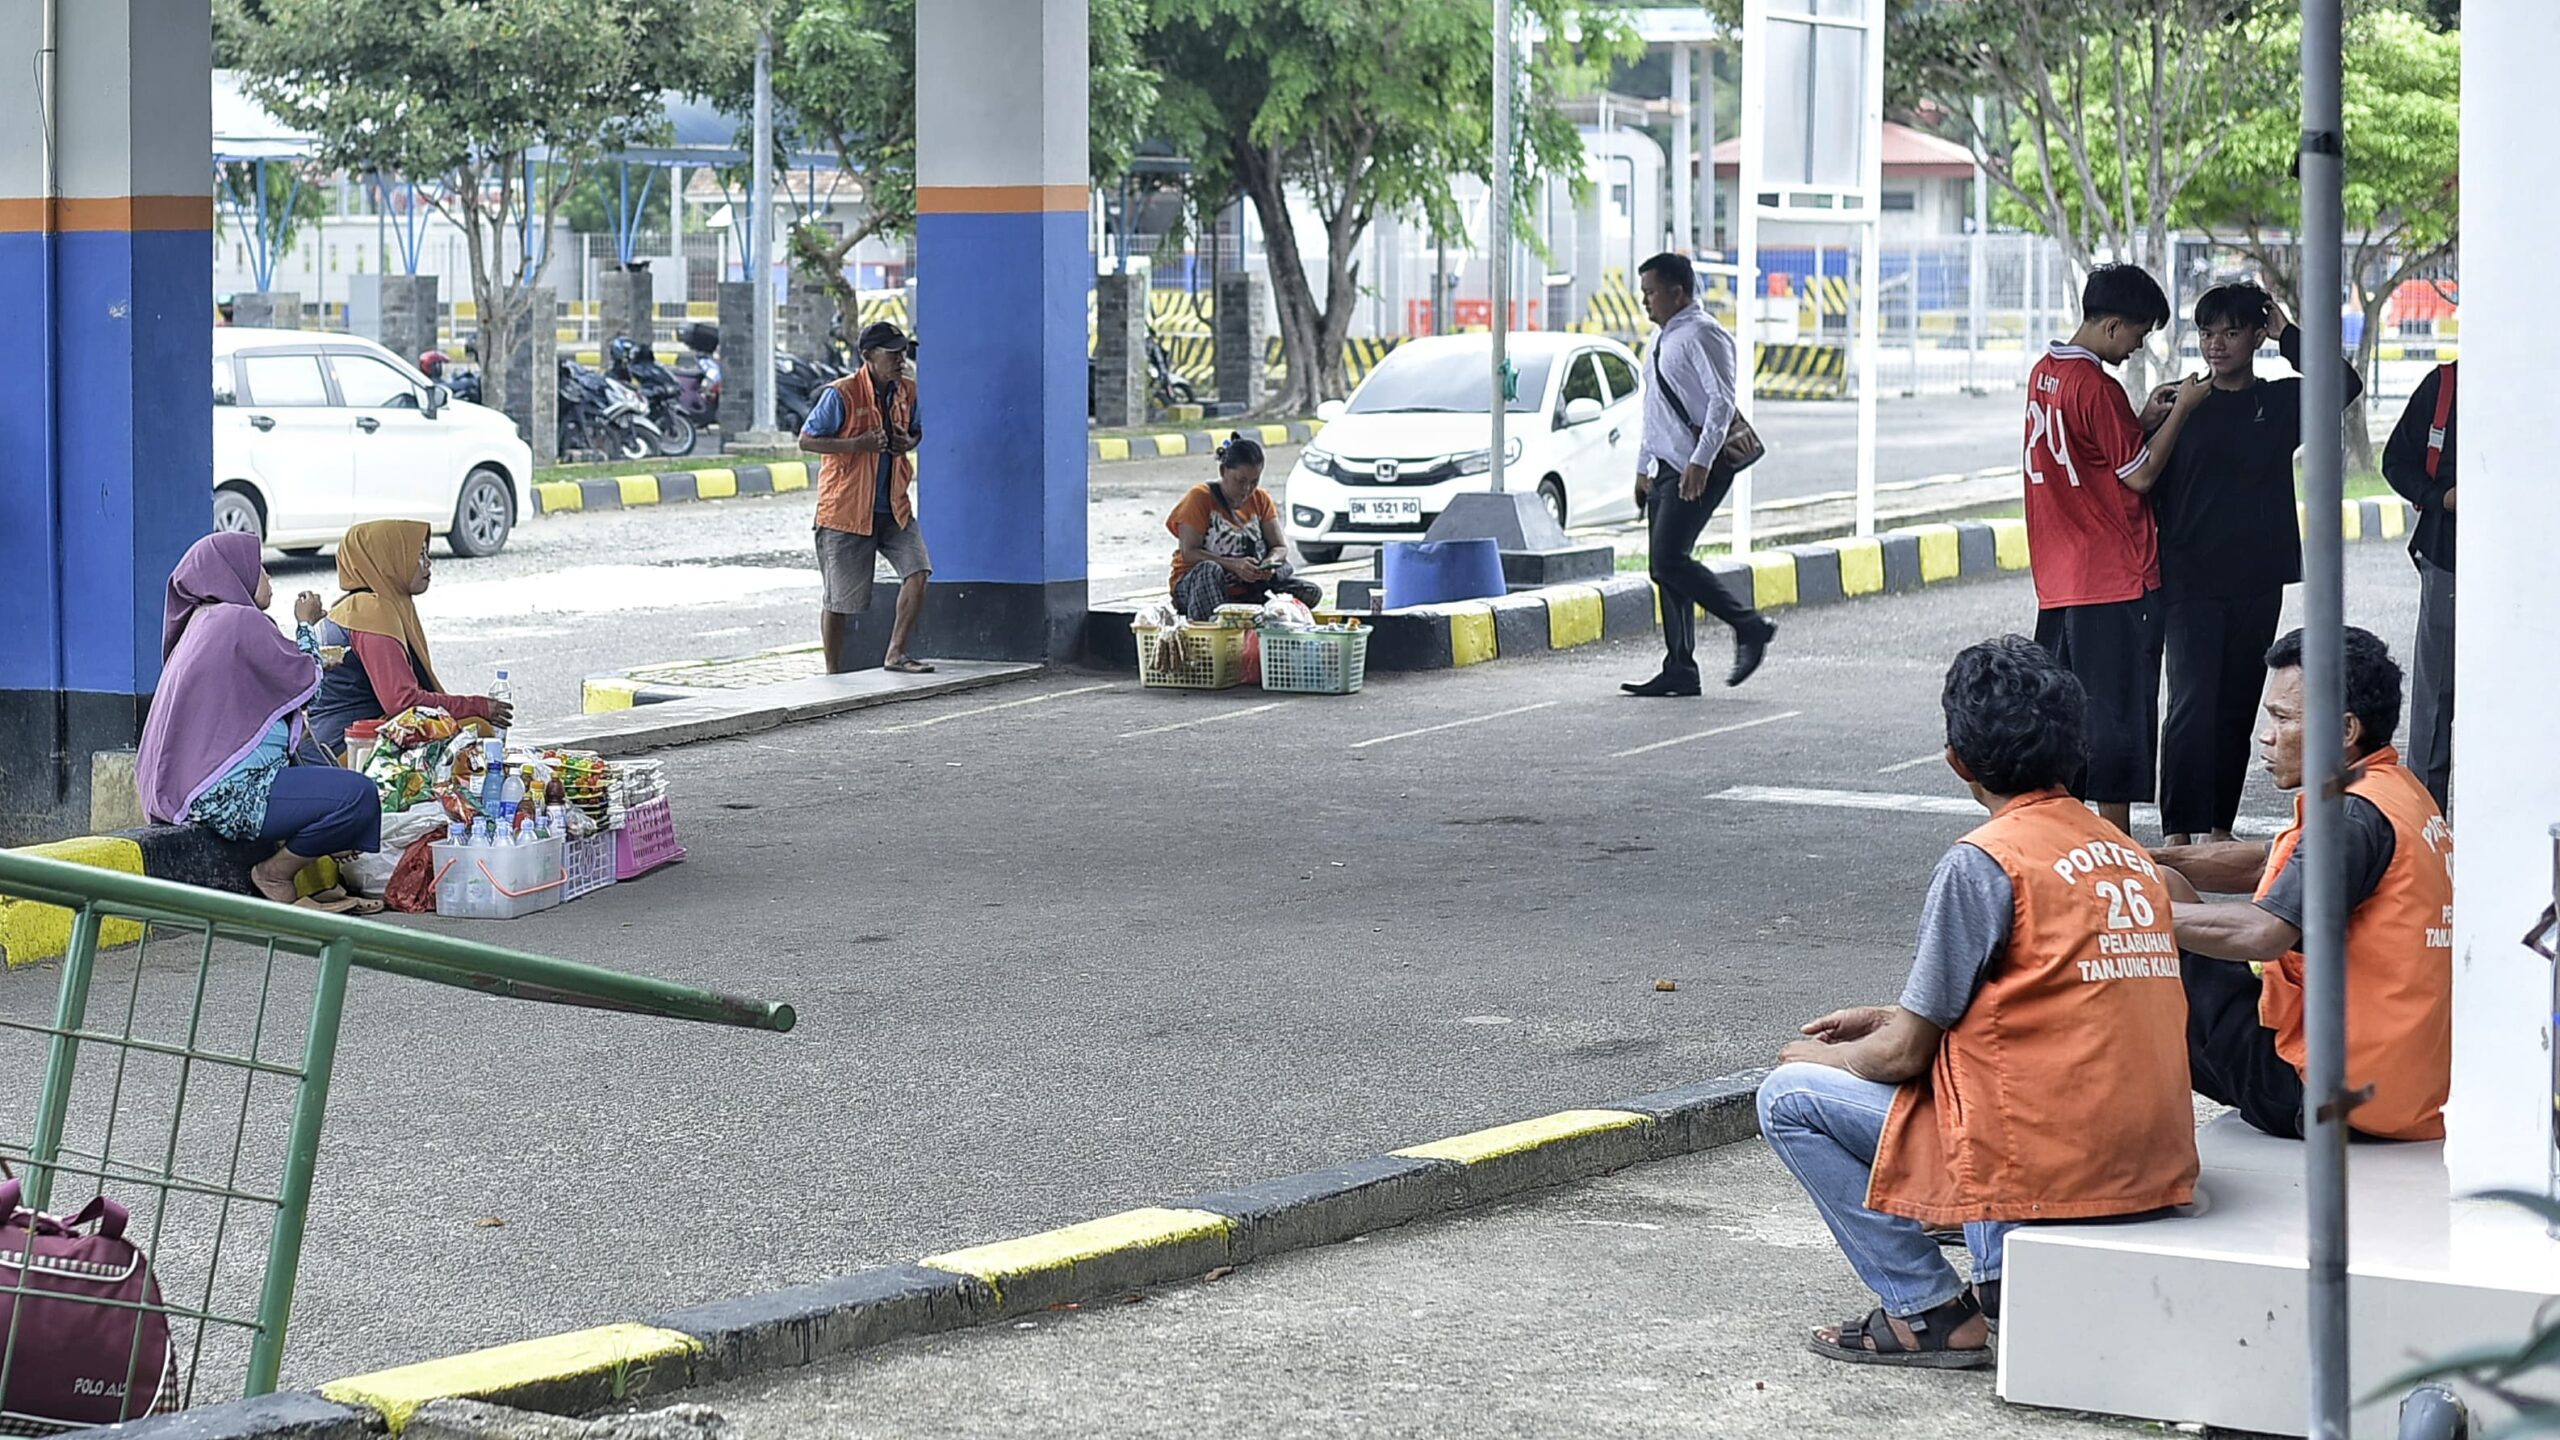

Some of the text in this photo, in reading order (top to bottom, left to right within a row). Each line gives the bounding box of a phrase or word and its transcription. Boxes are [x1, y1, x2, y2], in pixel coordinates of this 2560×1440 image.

[2025, 400, 2080, 487] 24
[1373, 502, 1398, 514] 1521
[1402, 502, 1418, 514] RD
[2053, 840, 2161, 886] PORTER
[2095, 877, 2155, 930] 26
[2098, 932, 2174, 955] PELABUHAN
[2077, 956, 2149, 982] TANJUNG
[73, 1377, 105, 1396] POLO
